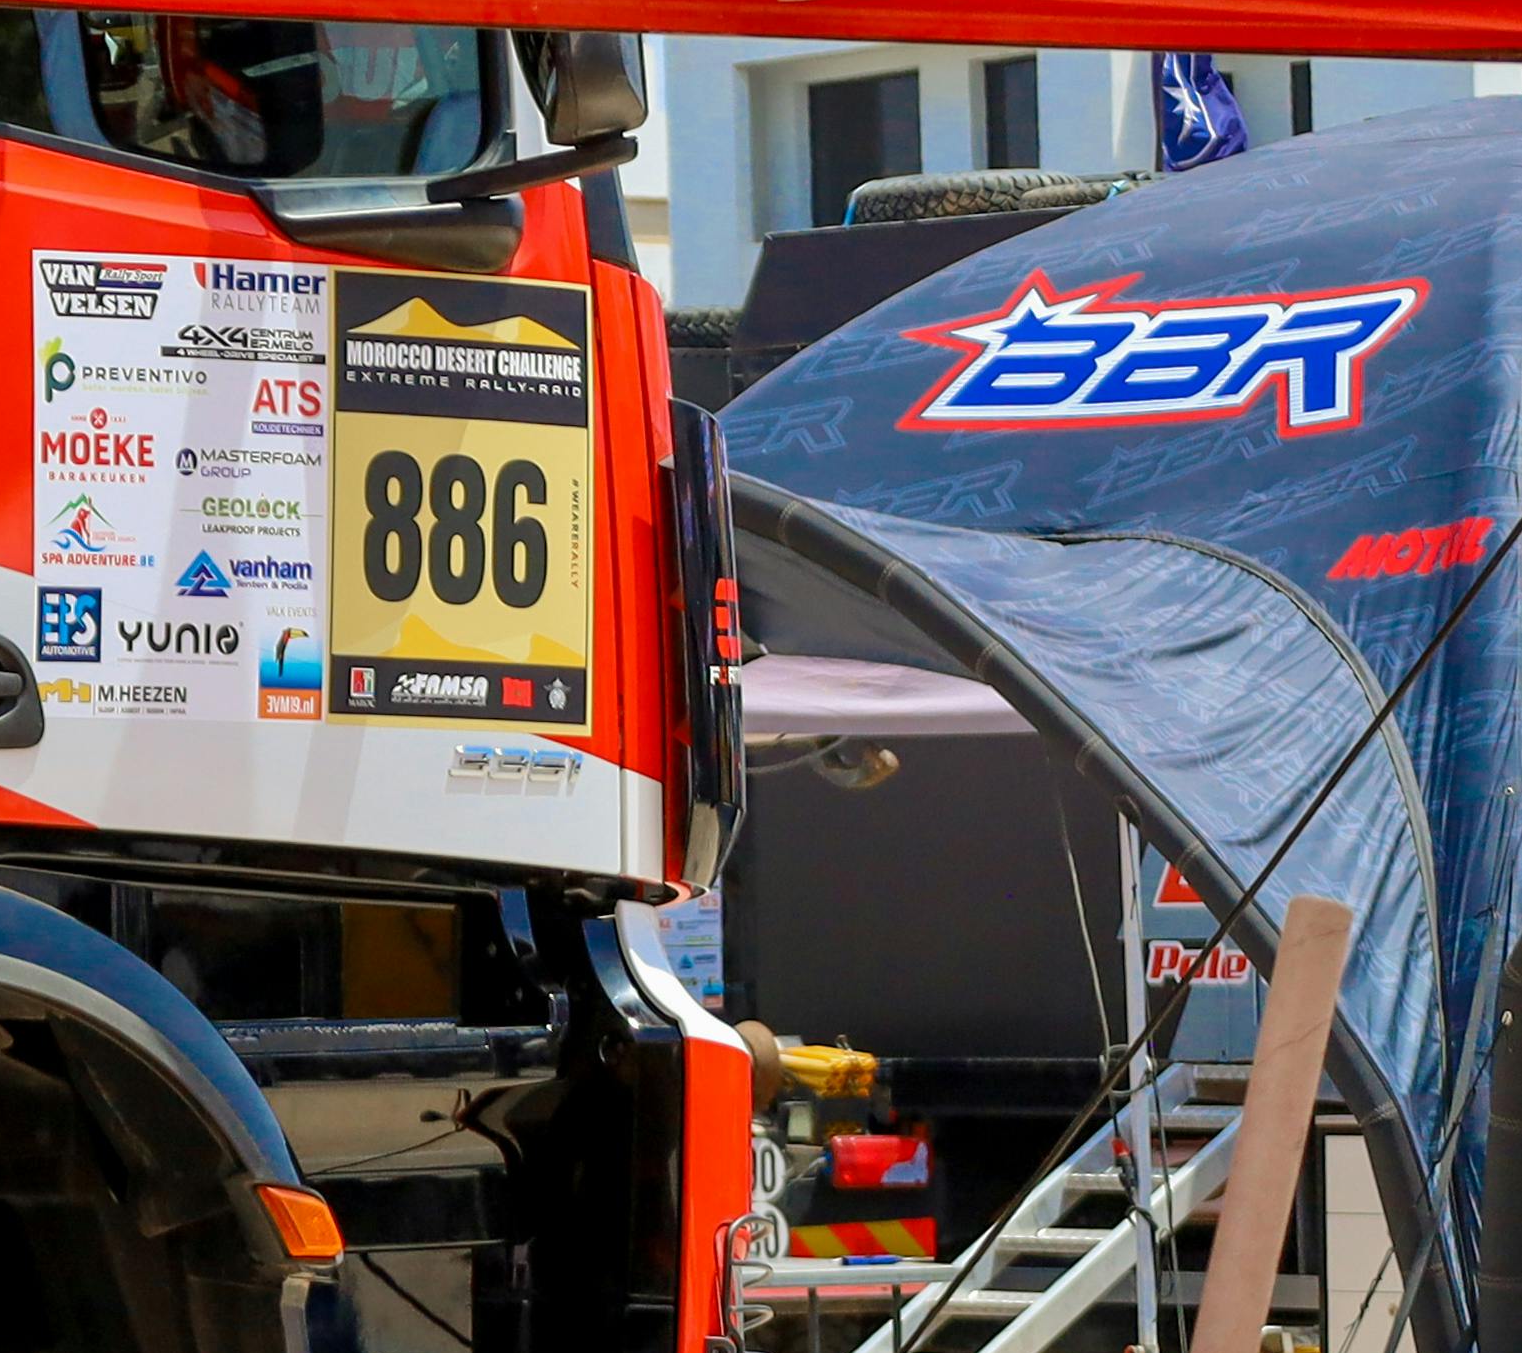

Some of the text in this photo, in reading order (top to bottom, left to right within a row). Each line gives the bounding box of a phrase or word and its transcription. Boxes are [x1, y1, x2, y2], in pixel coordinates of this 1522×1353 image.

[42, 263, 95, 286] VAN
[103, 270, 131, 282] Rally
[212, 263, 326, 295] Hamer
[52, 292, 153, 317] VELSEN
[211, 292, 321, 314] RALLYTEAM
[250, 328, 313, 340] CENTRUM
[250, 339, 313, 351] ERMELO
[346, 340, 581, 382] MOROCCO DESERT CHALLENGE
[913, 279, 1421, 429] BBR
[82, 367, 208, 384] PREVENTIVO
[253, 379, 321, 417] ATS
[465, 379, 581, 396] RALLY-RAID
[41, 432, 154, 467] MOEKE
[201, 449, 321, 466] MASTERFOAM
[201, 466, 251, 478] GROUP
[202, 496, 301, 520] GEOLOCK
[202, 524, 301, 536] LEAKPROOF PROJECTS
[364, 450, 547, 608] 886
[42, 553, 63, 564] SPA
[230, 555, 312, 580] vanham
[43, 593, 97, 645] EPS
[98, 685, 187, 703] M.HEEZEN
